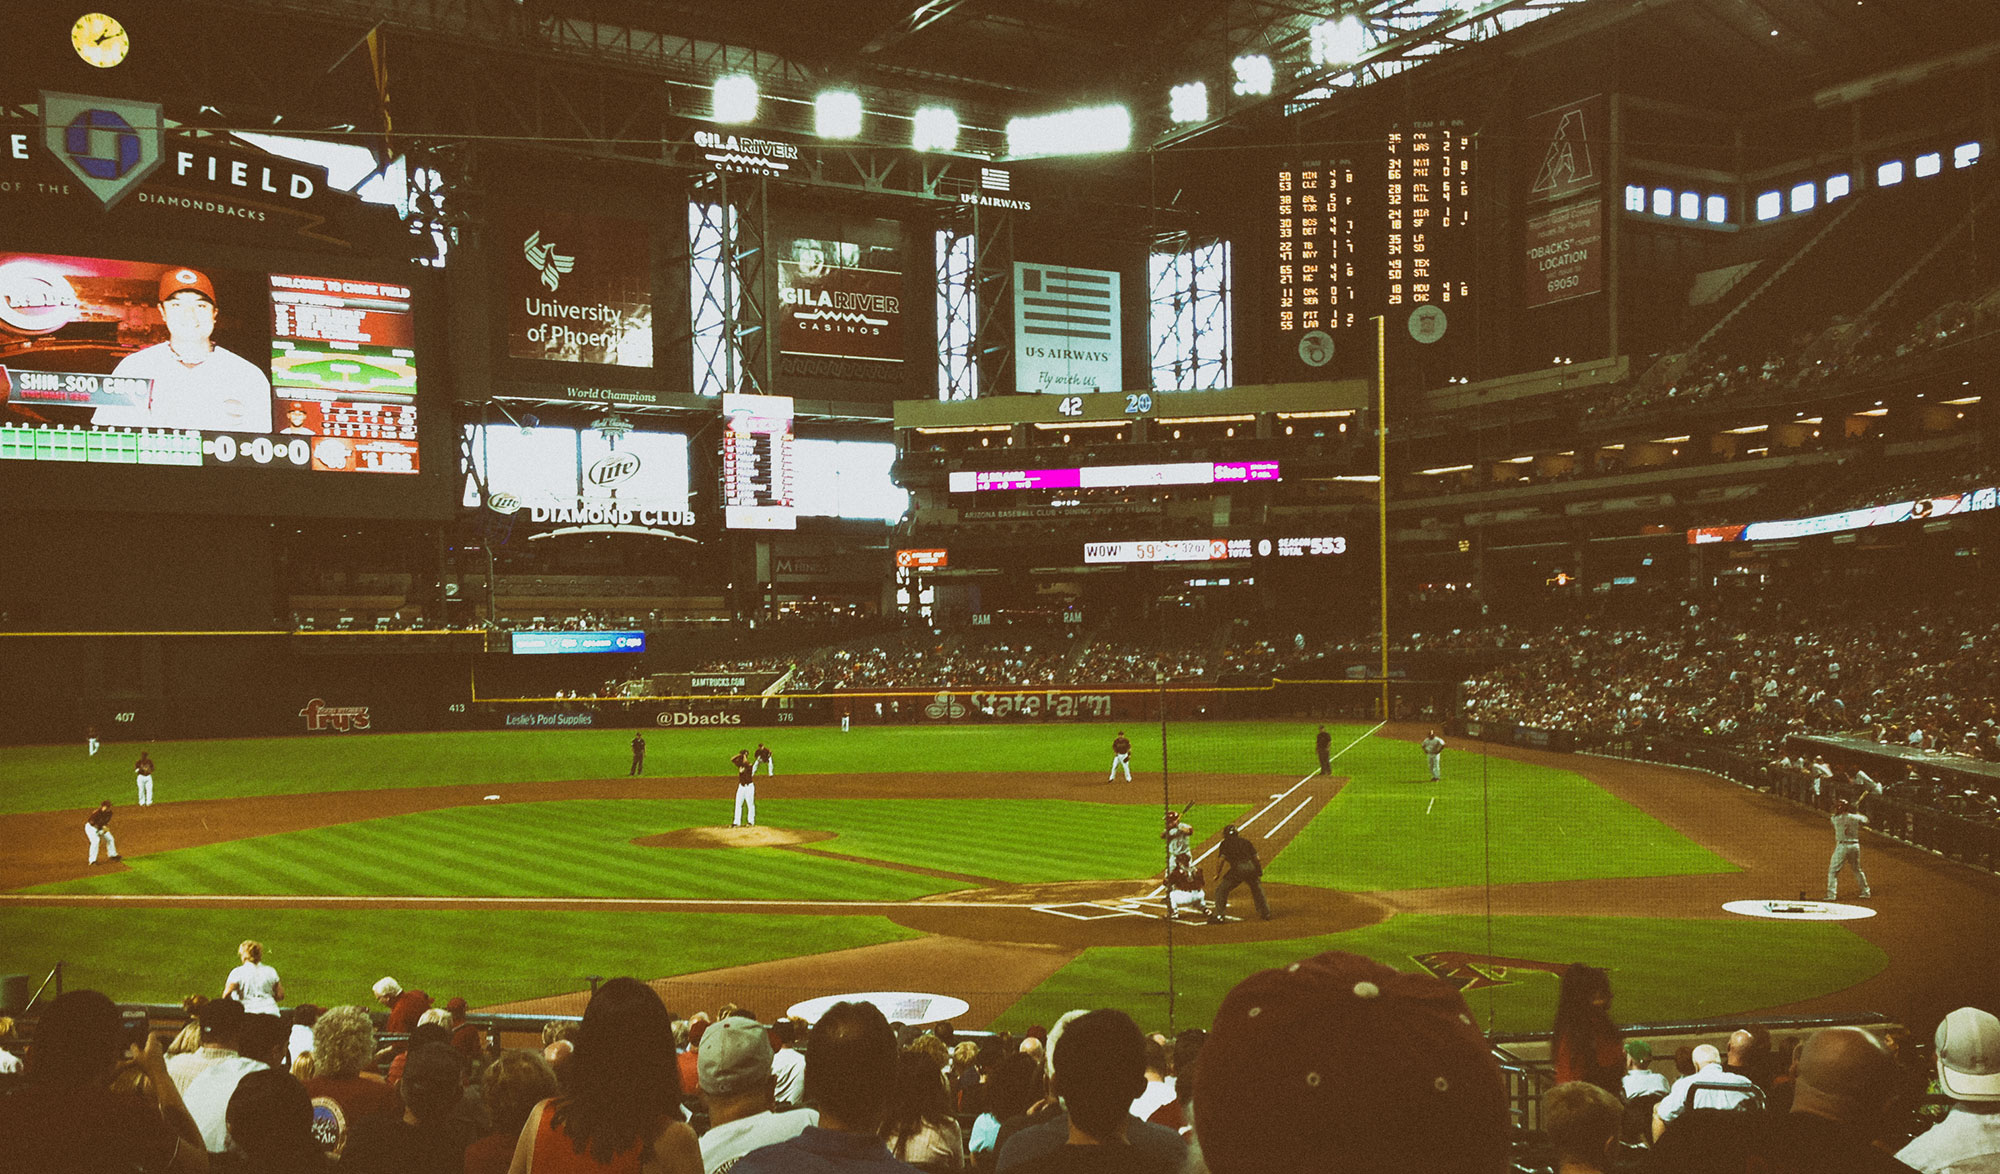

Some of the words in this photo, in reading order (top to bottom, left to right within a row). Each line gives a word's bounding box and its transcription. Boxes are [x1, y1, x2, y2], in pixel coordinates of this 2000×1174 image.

[693, 131, 740, 151] GILA
[740, 137, 798, 159] RIVER
[11, 134, 29, 160] E
[177, 151, 314, 199] FIELD
[715, 163, 780, 177] CASINOS
[1, 182, 21, 191] OF
[38, 183, 69, 195] THE
[138, 192, 266, 222] DIAMONDBACKS
[980, 196, 1031, 210] AIRWAYS
[1539, 249, 1588, 271] LOCATION
[270, 276, 326, 291] WELCOME
[326, 280, 342, 292] TO
[379, 286, 411, 298] FIELD
[1547, 275, 1579, 292] 69050
[781, 287, 833, 308] GILA
[834, 291, 899, 313] RIVER
[525, 297, 622, 328] University
[527, 323, 548, 342] of
[550, 325, 621, 348] Phoeni
[799, 321, 880, 335] CASINOS
[1047, 349, 1109, 362] AIRWAYS
[19, 373, 99, 393] SHIN-SOO
[1039, 371, 1053, 389] Fly
[1055, 373, 1080, 386] with
[567, 387, 599, 399] World
[600, 389, 657, 403] Champions
[1125, 394, 1152, 413] 20
[1058, 397, 1083, 416] 42
[597, 459, 634, 486] Lite
[494, 494, 521, 508] Lite
[531, 507, 633, 524] DIAMOND
[639, 510, 696, 526] CLUB
[998, 509, 1035, 518] BASEBALL
[1258, 539, 1271, 556] 0
[1310, 537, 1346, 554] 553
[973, 614, 991, 625] RAM
[1064, 612, 1082, 623] RAM
[692, 678, 745, 687] RAMTRUCKS.COM
[449, 704, 466, 712] 413
[971, 690, 1041, 717] State
[1047, 689, 1112, 717] Farm
[115, 712, 135, 722] 407
[506, 714, 536, 726] Leslie's
[537, 714, 557, 725] Pool
[557, 714, 592, 727] Supplies
[656, 711, 741, 726] @Dbacks
